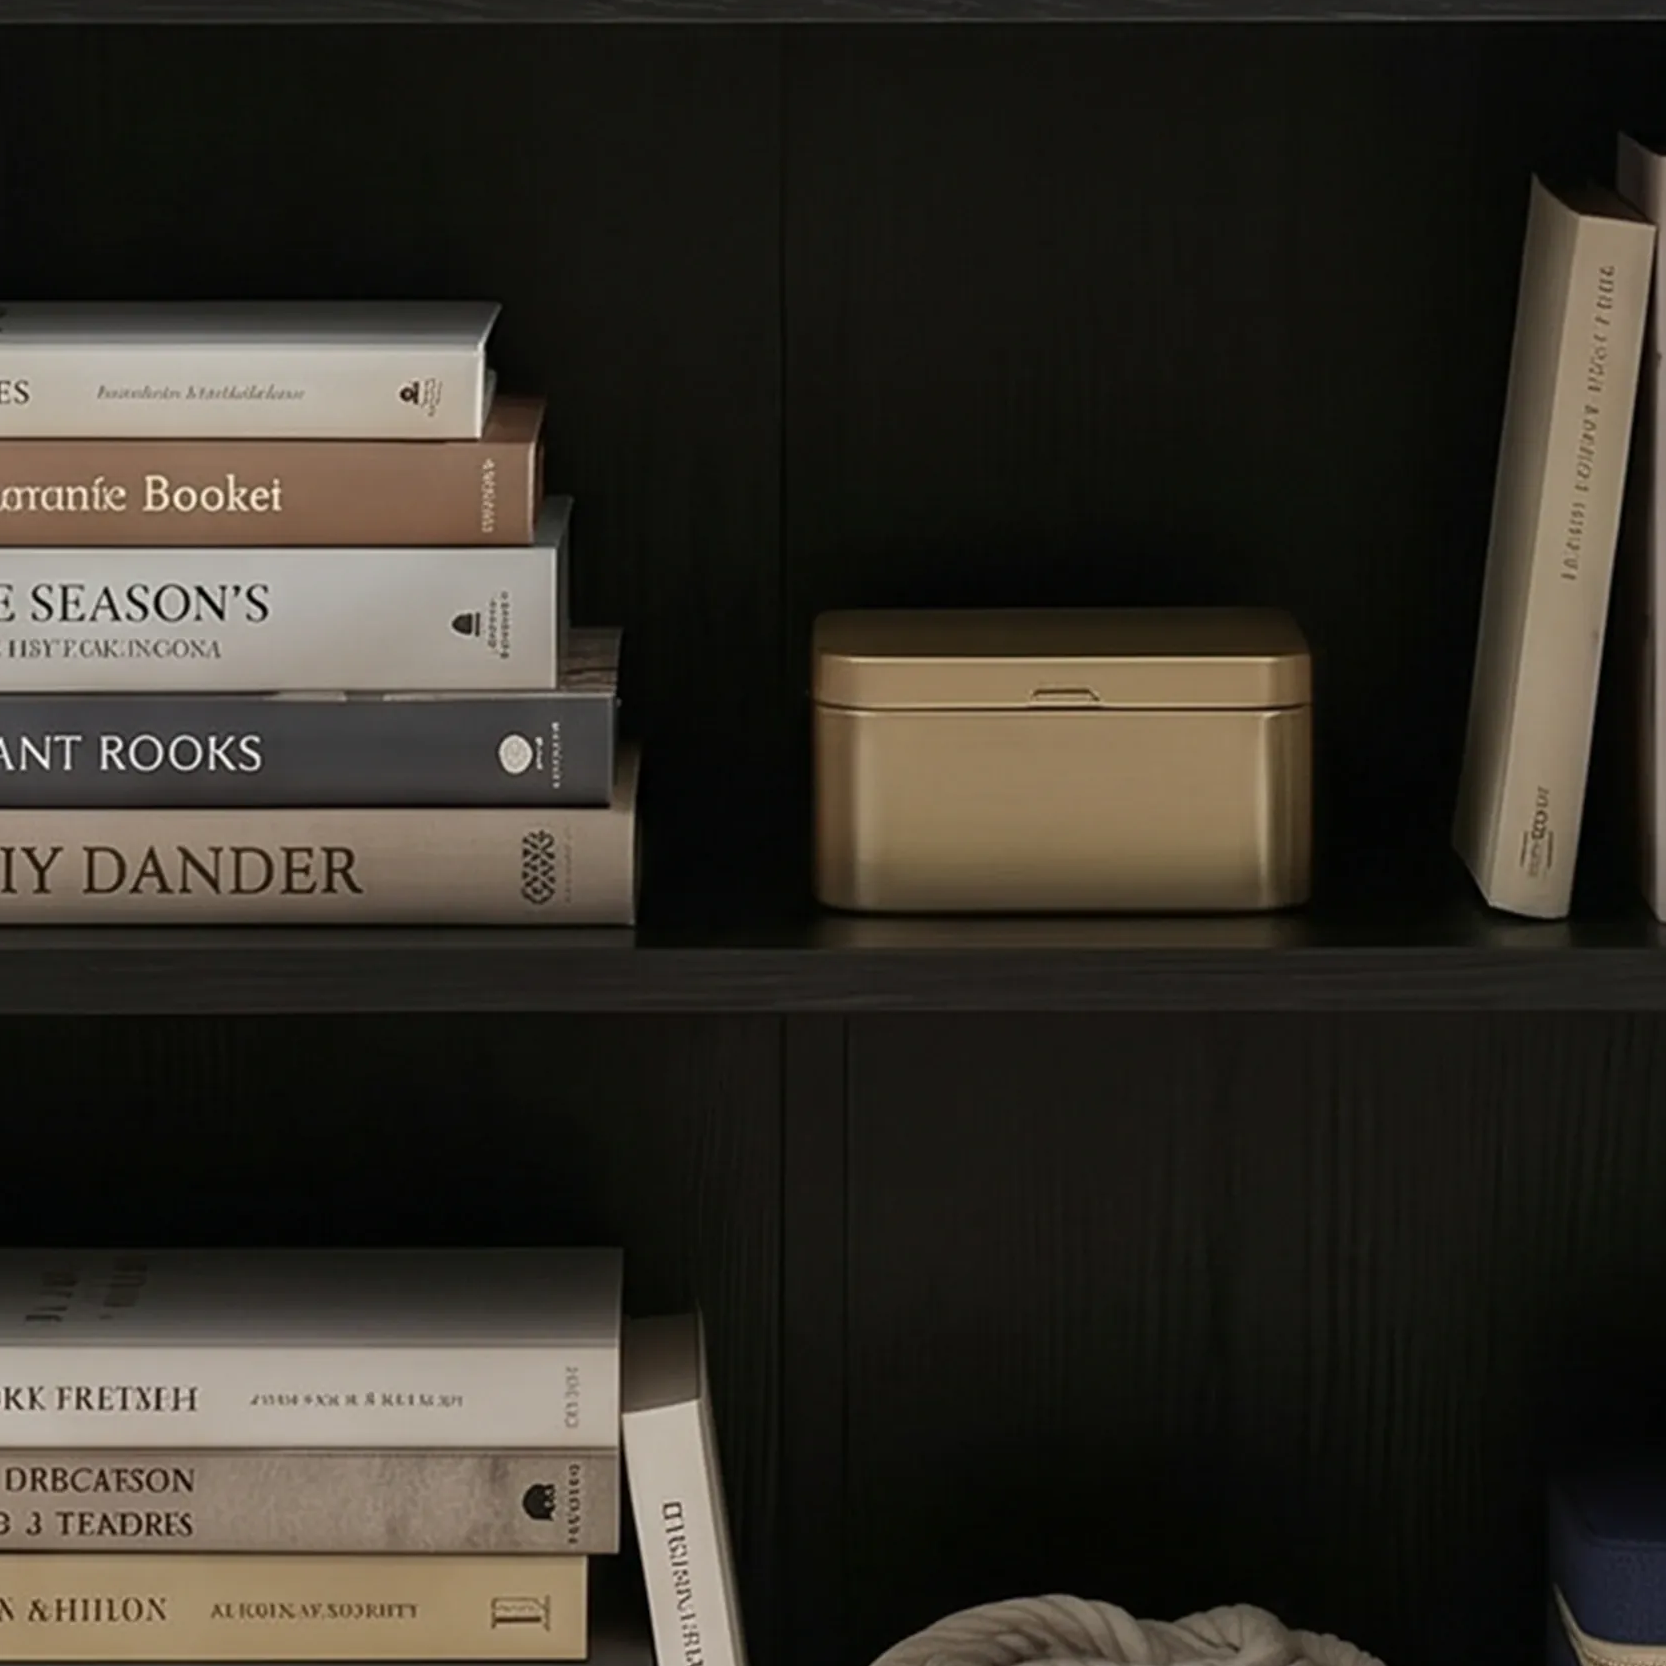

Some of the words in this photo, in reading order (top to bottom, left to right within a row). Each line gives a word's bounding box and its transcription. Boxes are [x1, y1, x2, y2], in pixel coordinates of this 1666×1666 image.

[29, 582, 270, 624] SEASON'S
[99, 734, 264, 774] ROOKS
[80, 844, 365, 896] DANDER
